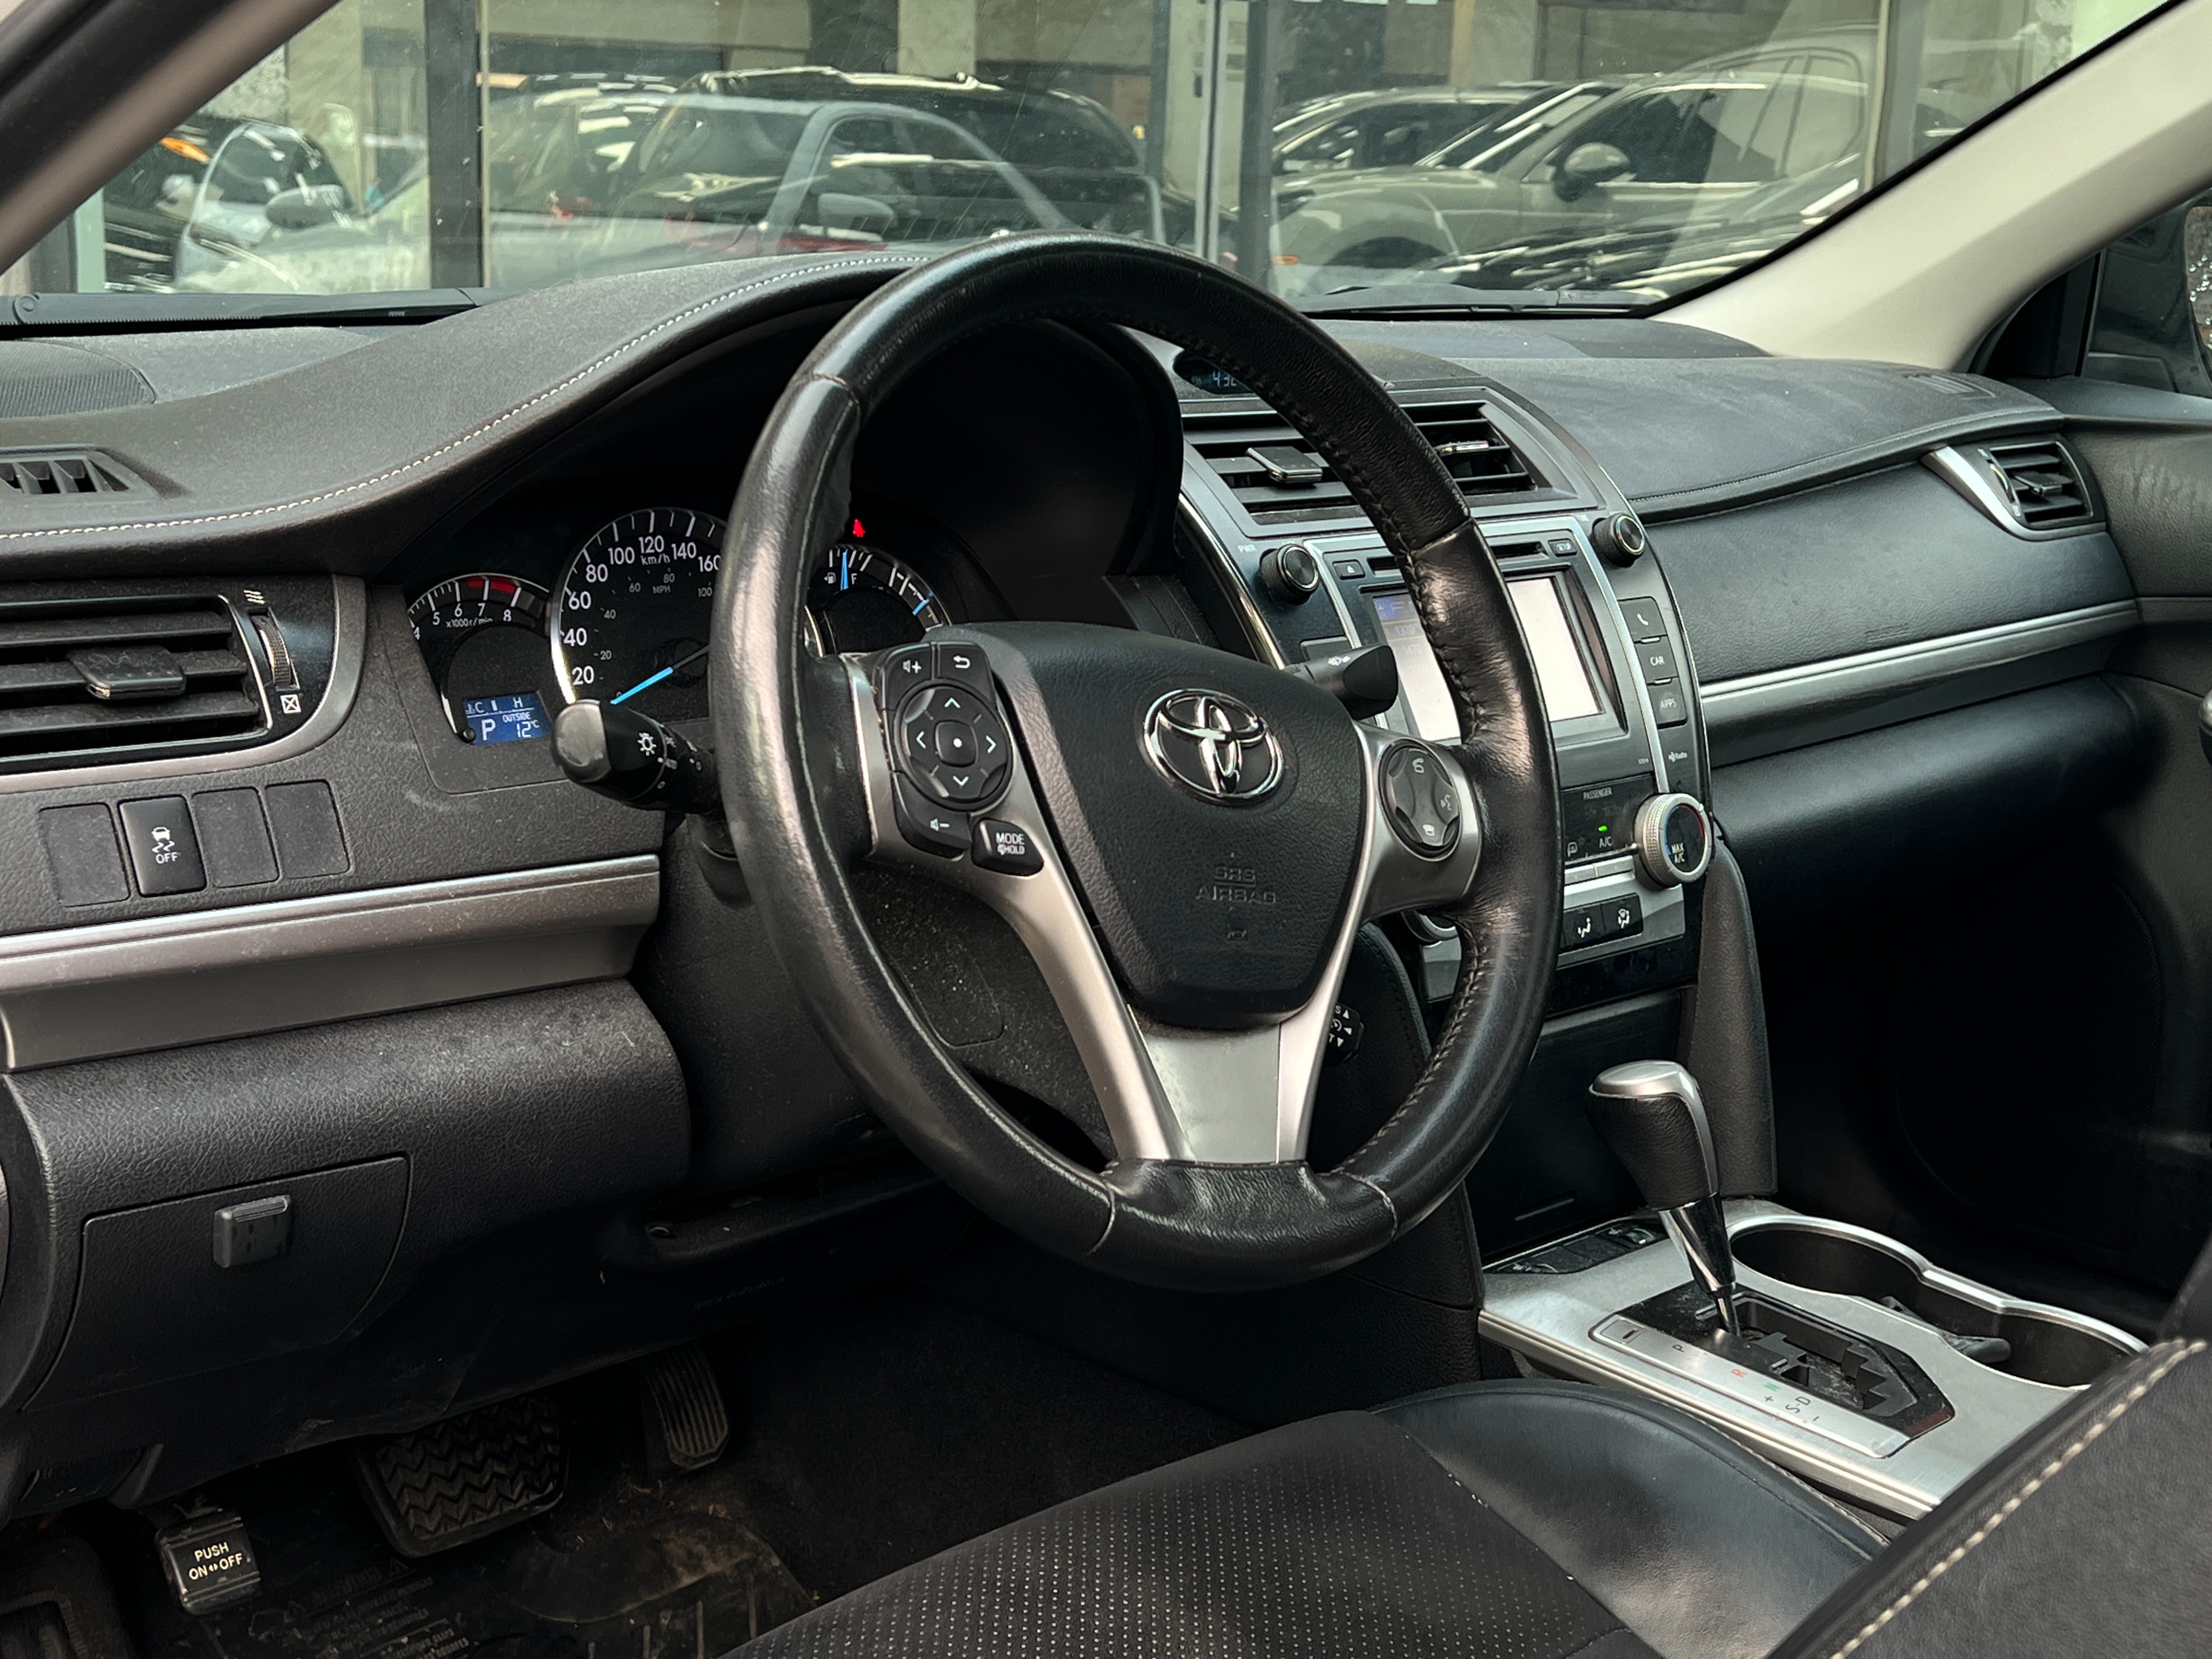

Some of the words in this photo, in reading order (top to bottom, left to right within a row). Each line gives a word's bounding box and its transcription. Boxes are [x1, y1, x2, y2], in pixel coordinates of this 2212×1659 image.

[639, 536, 665, 554] 120
[671, 541, 697, 560] 140
[608, 546, 635, 566] 100
[640, 554, 671, 566] km/h
[585, 563, 608, 584] 80
[663, 573, 676, 583] 80
[850, 573, 858, 585] F
[628, 583, 641, 593] 60
[652, 585, 671, 594] MPH
[698, 587, 713, 597] 100
[568, 591, 592, 611] 60
[454, 603, 463, 617] 6
[478, 603, 486, 617] 7
[502, 609, 512, 622] 8
[604, 609, 617, 620] 40
[432, 612, 440, 625] 5
[413, 626, 421, 640] 4
[564, 628, 588, 646] 40
[600, 650, 612, 660] 20
[1650, 656, 1665, 666] CAR
[572, 666, 594, 685] 20
[475, 702, 485, 714] C
[512, 696, 524, 709] H
[1660, 698, 1677, 710] APPS
[502, 711, 532, 724] OUTSIDE
[481, 718, 496, 741] P
[1582, 787, 1613, 801] PASSENGER
[995, 832, 1025, 845] MODE
[1599, 835, 1613, 849] A/C
[1006, 845, 1025, 855] HOLD
[1671, 842, 1684, 854] MAX
[156, 852, 178, 864] OFF
[1674, 853, 1685, 863] A/C
[1214, 865, 1256, 881] SRS
[1195, 885, 1277, 905] AIRBAG
[1672, 1343, 1685, 1353] P
[1794, 1395, 1812, 1406] D
[1785, 1403, 1801, 1414] S
[194, 1541, 230, 1562] PUSH
[188, 1563, 209, 1581] ON
[218, 1552, 244, 1571] OFF
